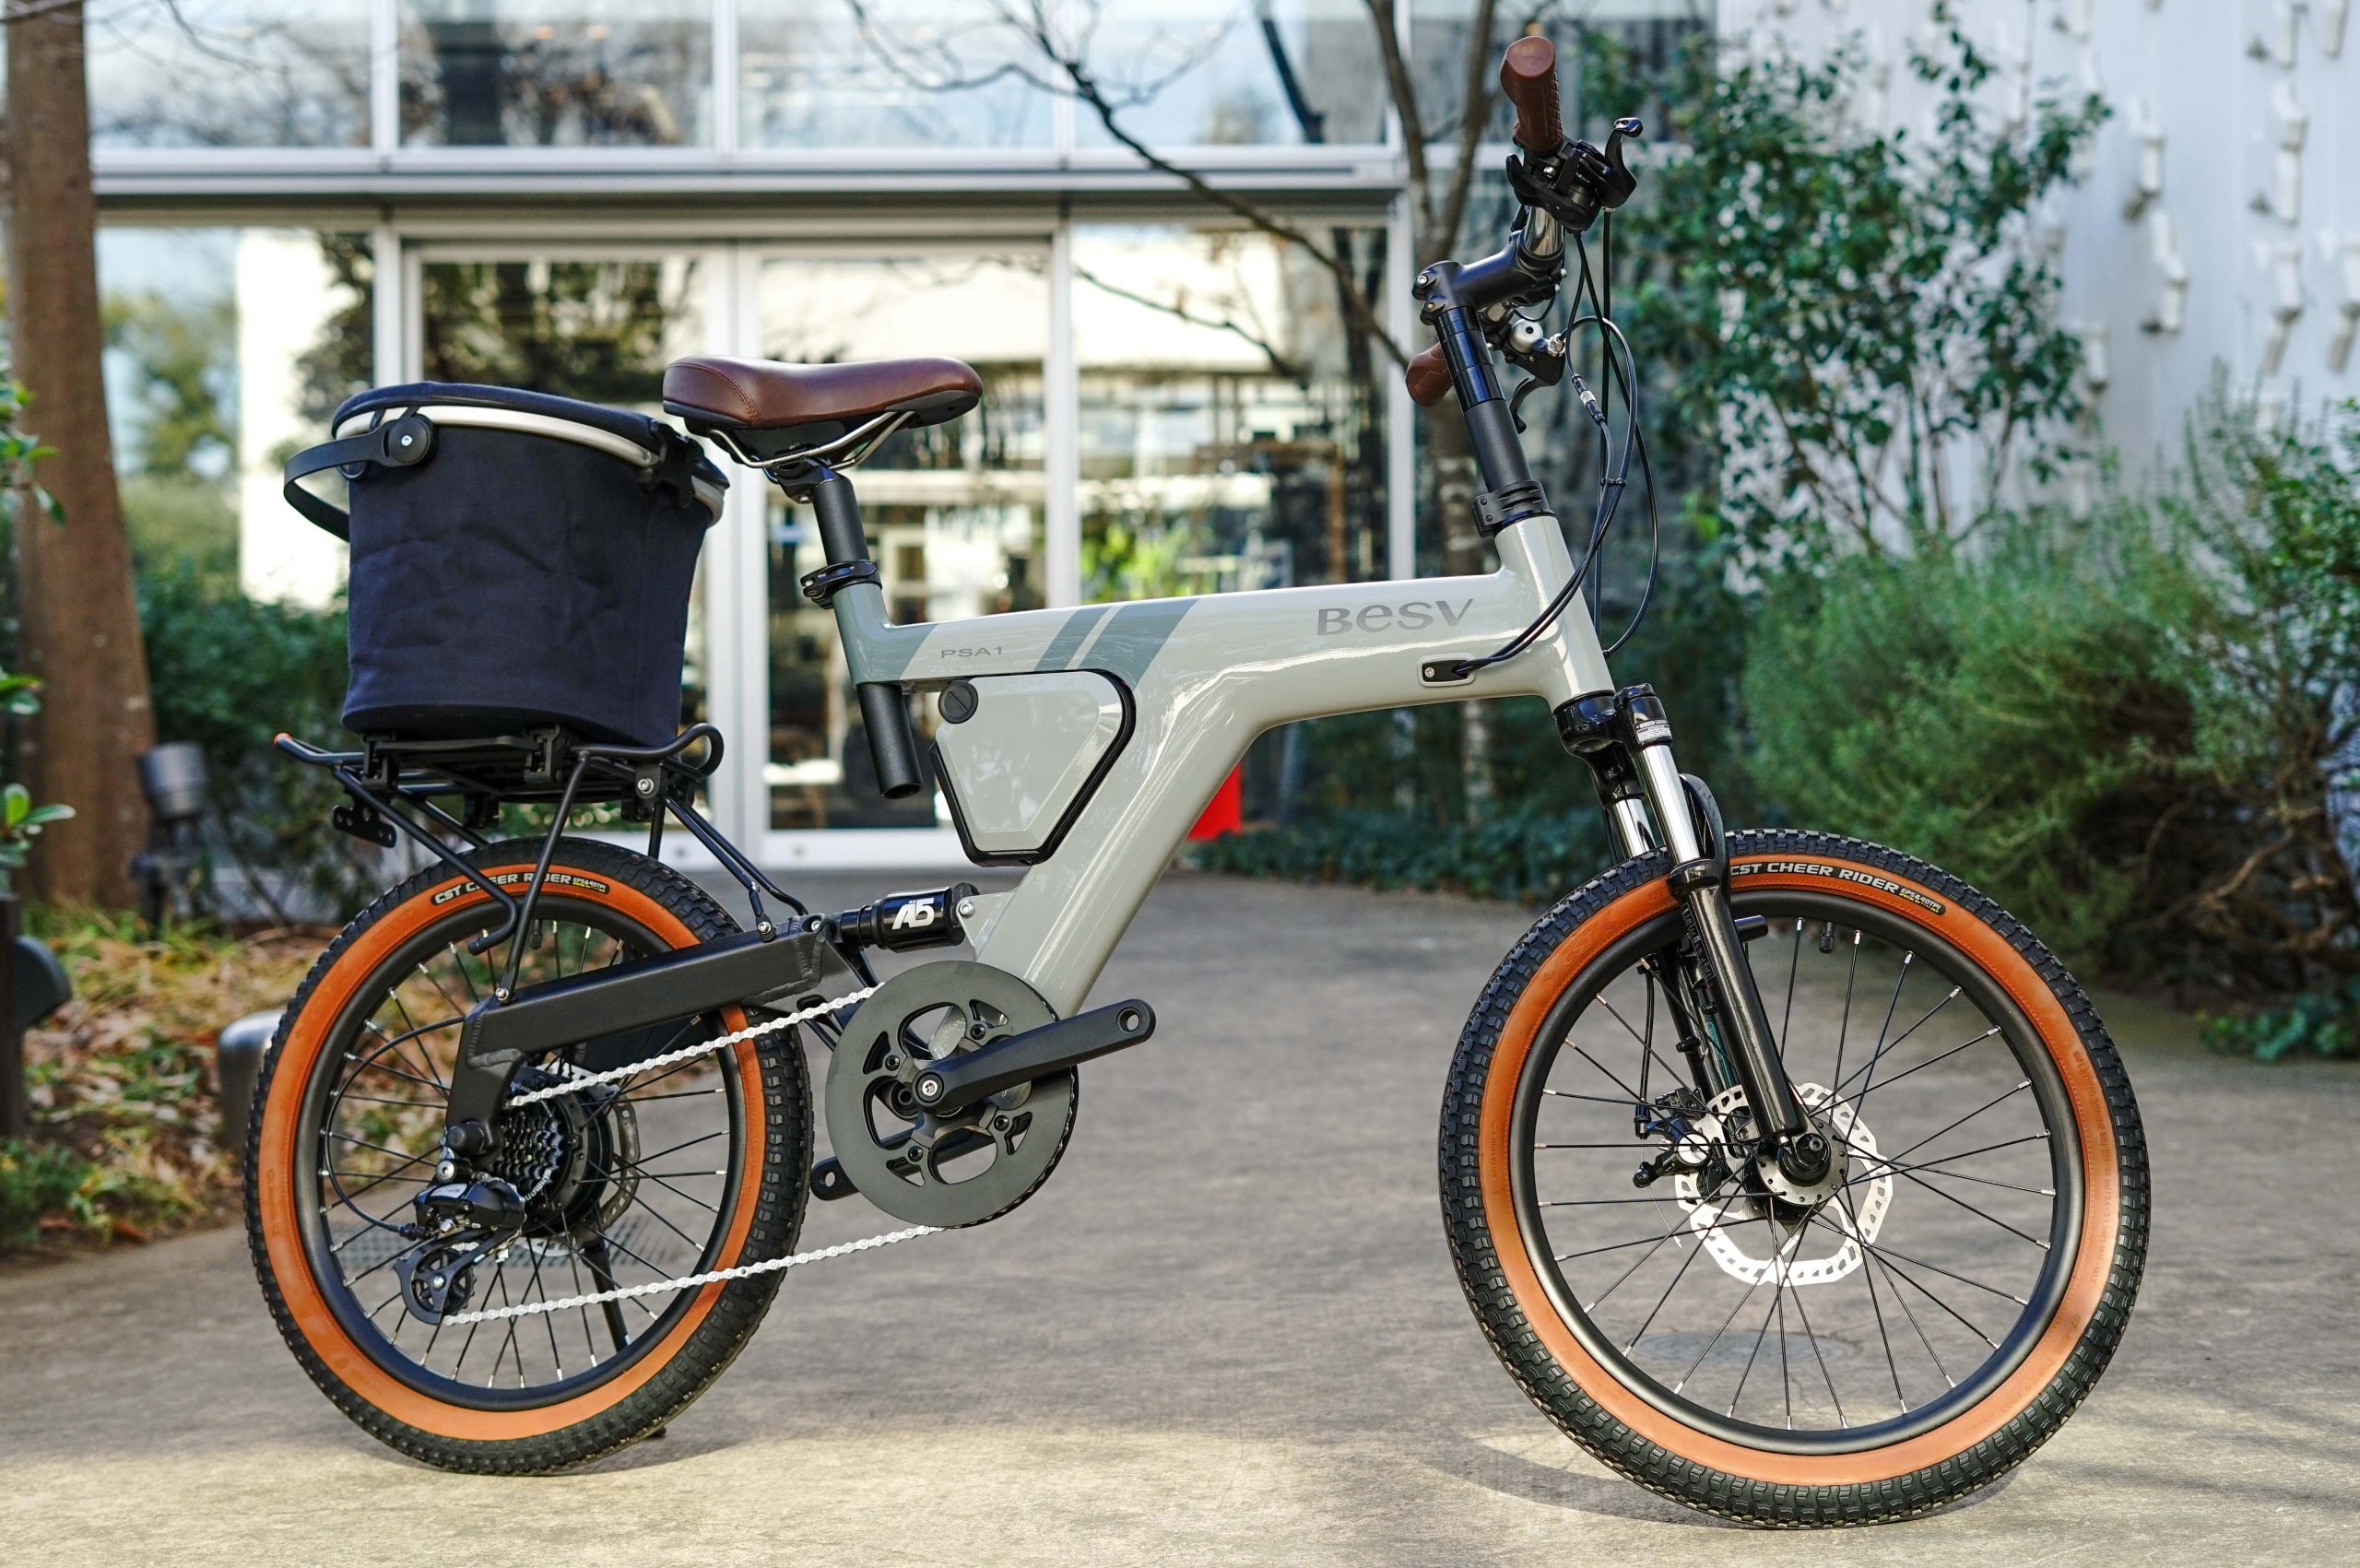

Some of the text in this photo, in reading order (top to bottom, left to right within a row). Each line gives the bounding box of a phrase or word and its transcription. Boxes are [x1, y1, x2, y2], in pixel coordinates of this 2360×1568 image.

[941, 646, 1002, 658] PSA1
[1730, 863, 1762, 876] CST
[1766, 862, 1834, 877] CHEER
[1838, 868, 1900, 894] RIDER
[434, 885, 461, 903] CST
